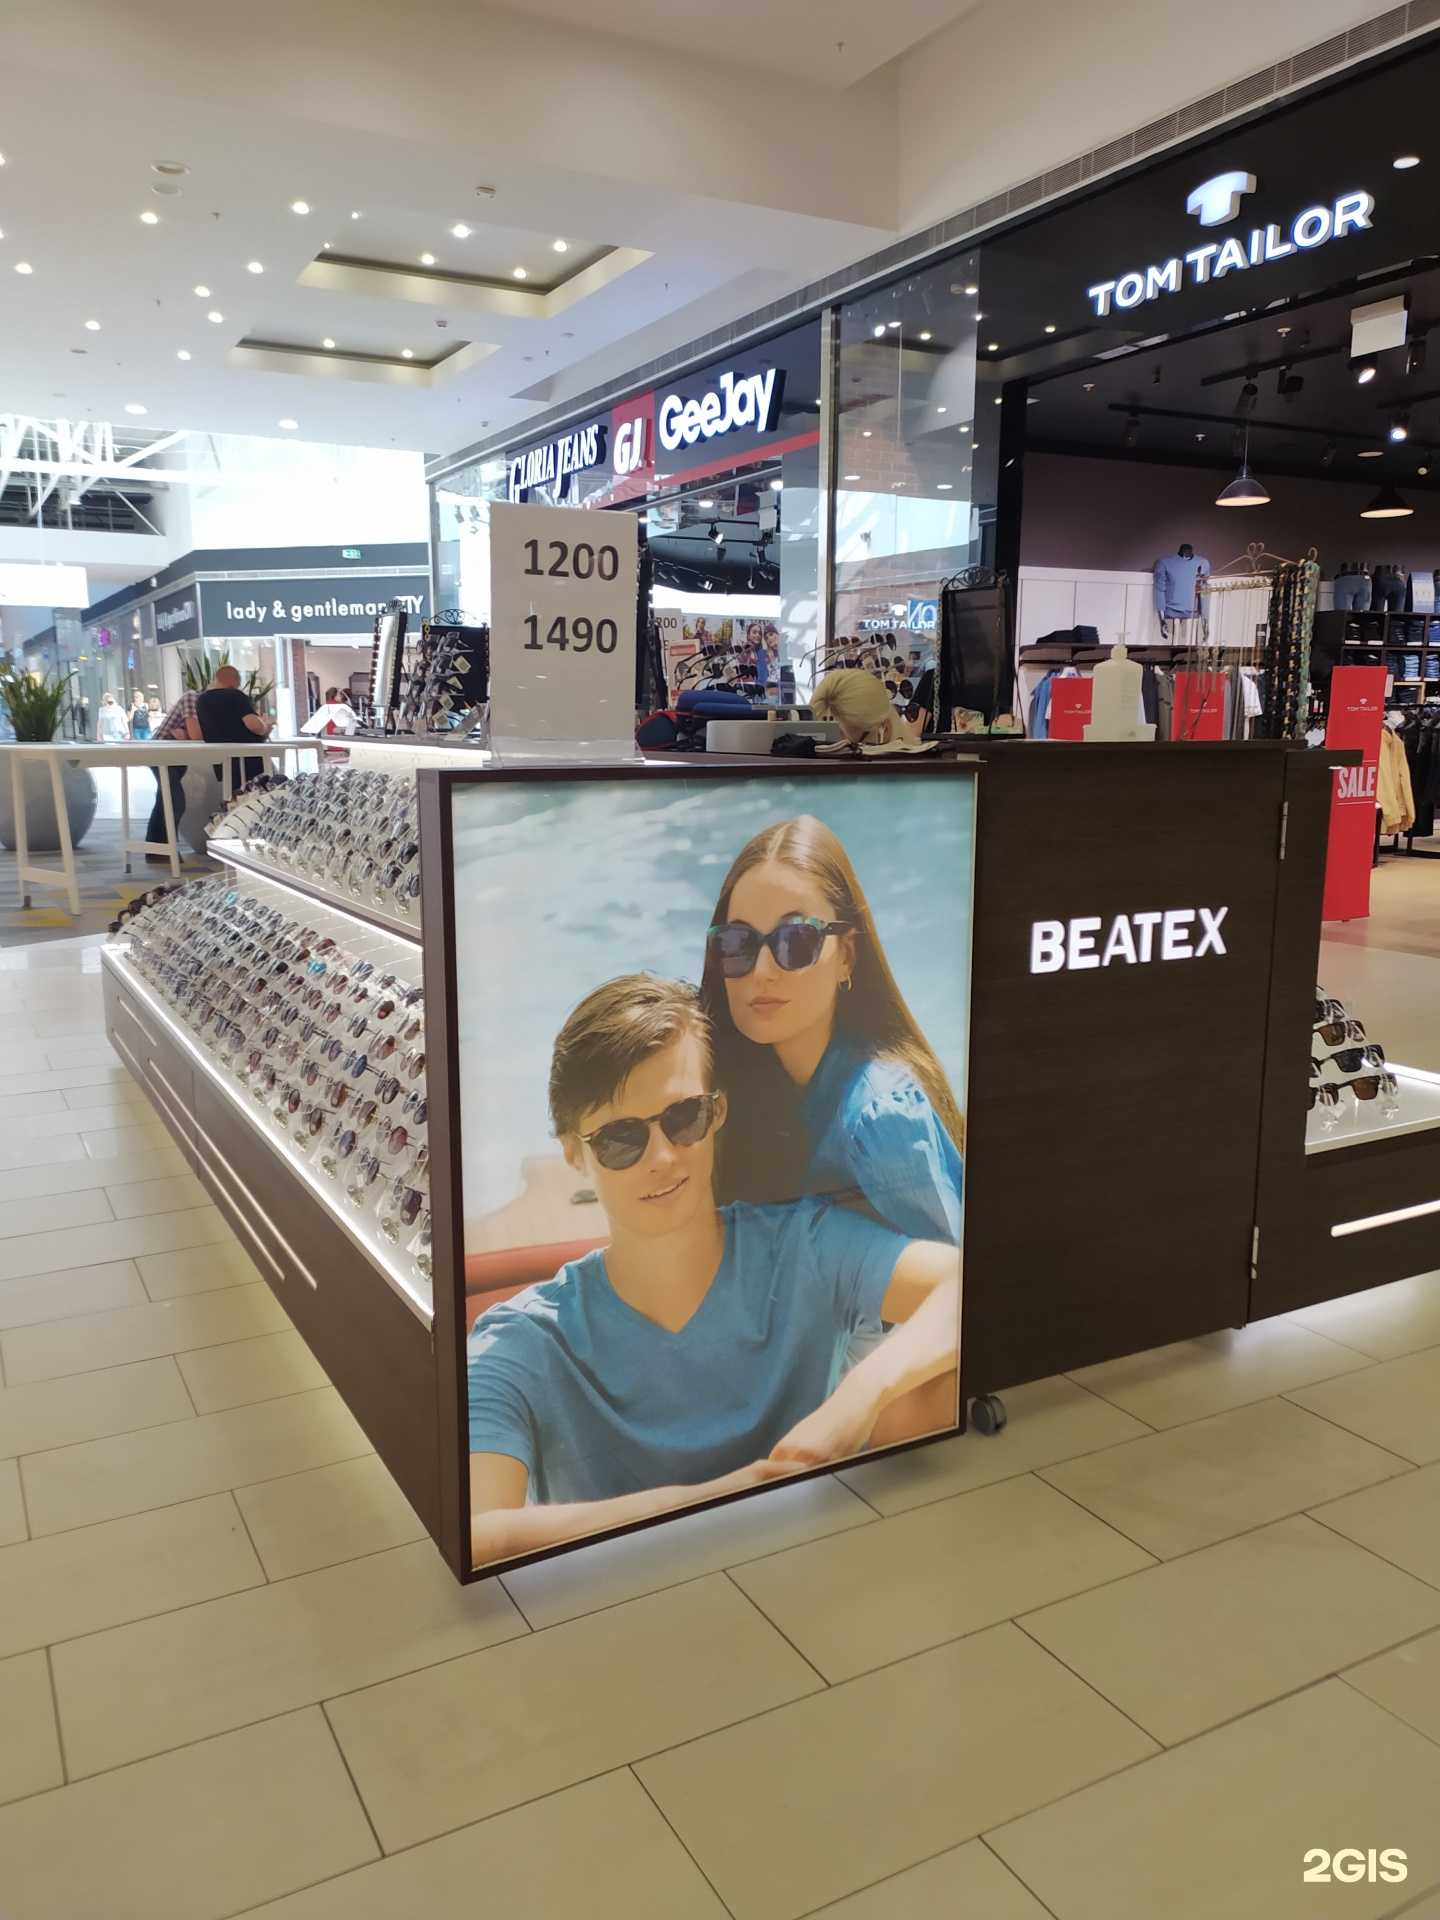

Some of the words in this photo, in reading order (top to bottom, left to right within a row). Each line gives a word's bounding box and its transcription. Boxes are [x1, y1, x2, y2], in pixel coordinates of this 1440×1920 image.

[1088, 258, 1182, 317] TOM
[1186, 190, 1375, 283] TAILOR
[659, 368, 777, 451] GeeJay
[509, 443, 555, 504] GLORIA
[553, 423, 600, 499] JEANS
[523, 539, 620, 581] 1200
[226, 601, 265, 623] lady
[272, 600, 287, 619] &
[864, 619, 890, 630] TOM
[523, 614, 618, 654] 1490
[1337, 766, 1377, 799] SALE
[1030, 906, 1229, 974] BEATEX
